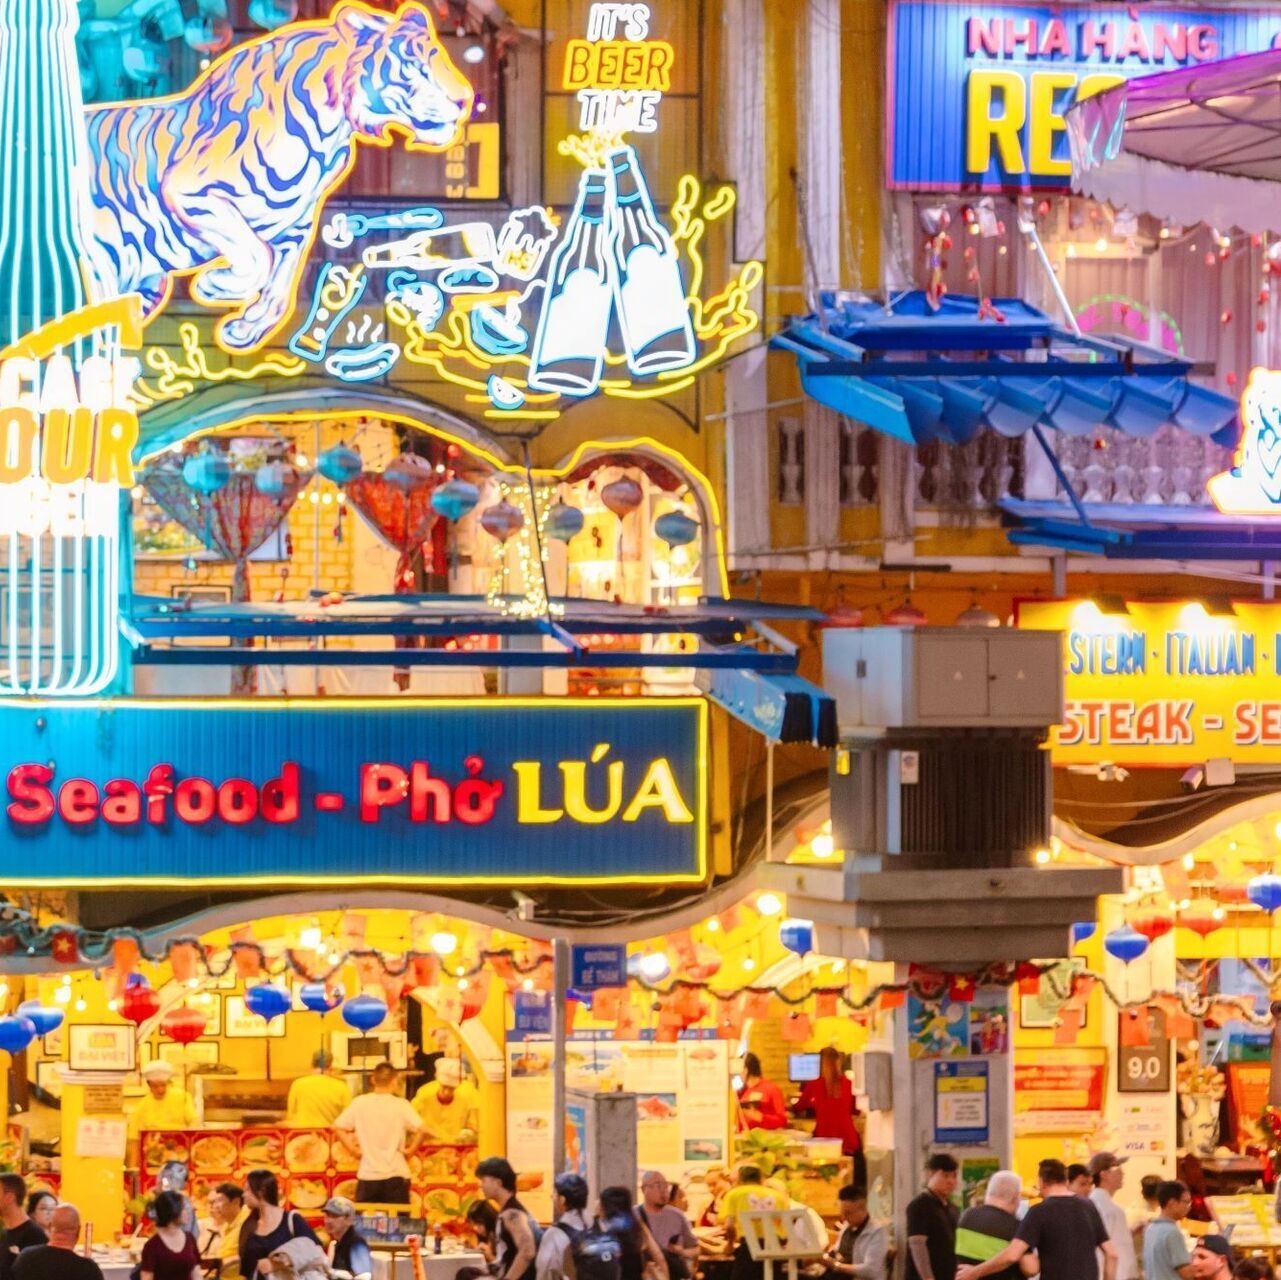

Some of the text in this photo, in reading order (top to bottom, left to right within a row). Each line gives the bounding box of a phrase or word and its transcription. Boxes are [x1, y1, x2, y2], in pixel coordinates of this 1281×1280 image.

[587, 3, 650, 42] IT'S
[968, 4, 1219, 63] NHÀ HÀNG
[563, 39, 674, 91] BEER
[577, 88, 662, 133] TIME
[968, 69, 1128, 176] RE
[1069, 631, 1146, 675] STERN
[1166, 631, 1255, 675] ITALIAN
[1058, 700, 1195, 745] STEAK
[6, 762, 301, 825] Seafood
[360, 753, 505, 824] Phở
[512, 743, 694, 824] LÚA
[1124, 1141, 1145, 1150] VISA
